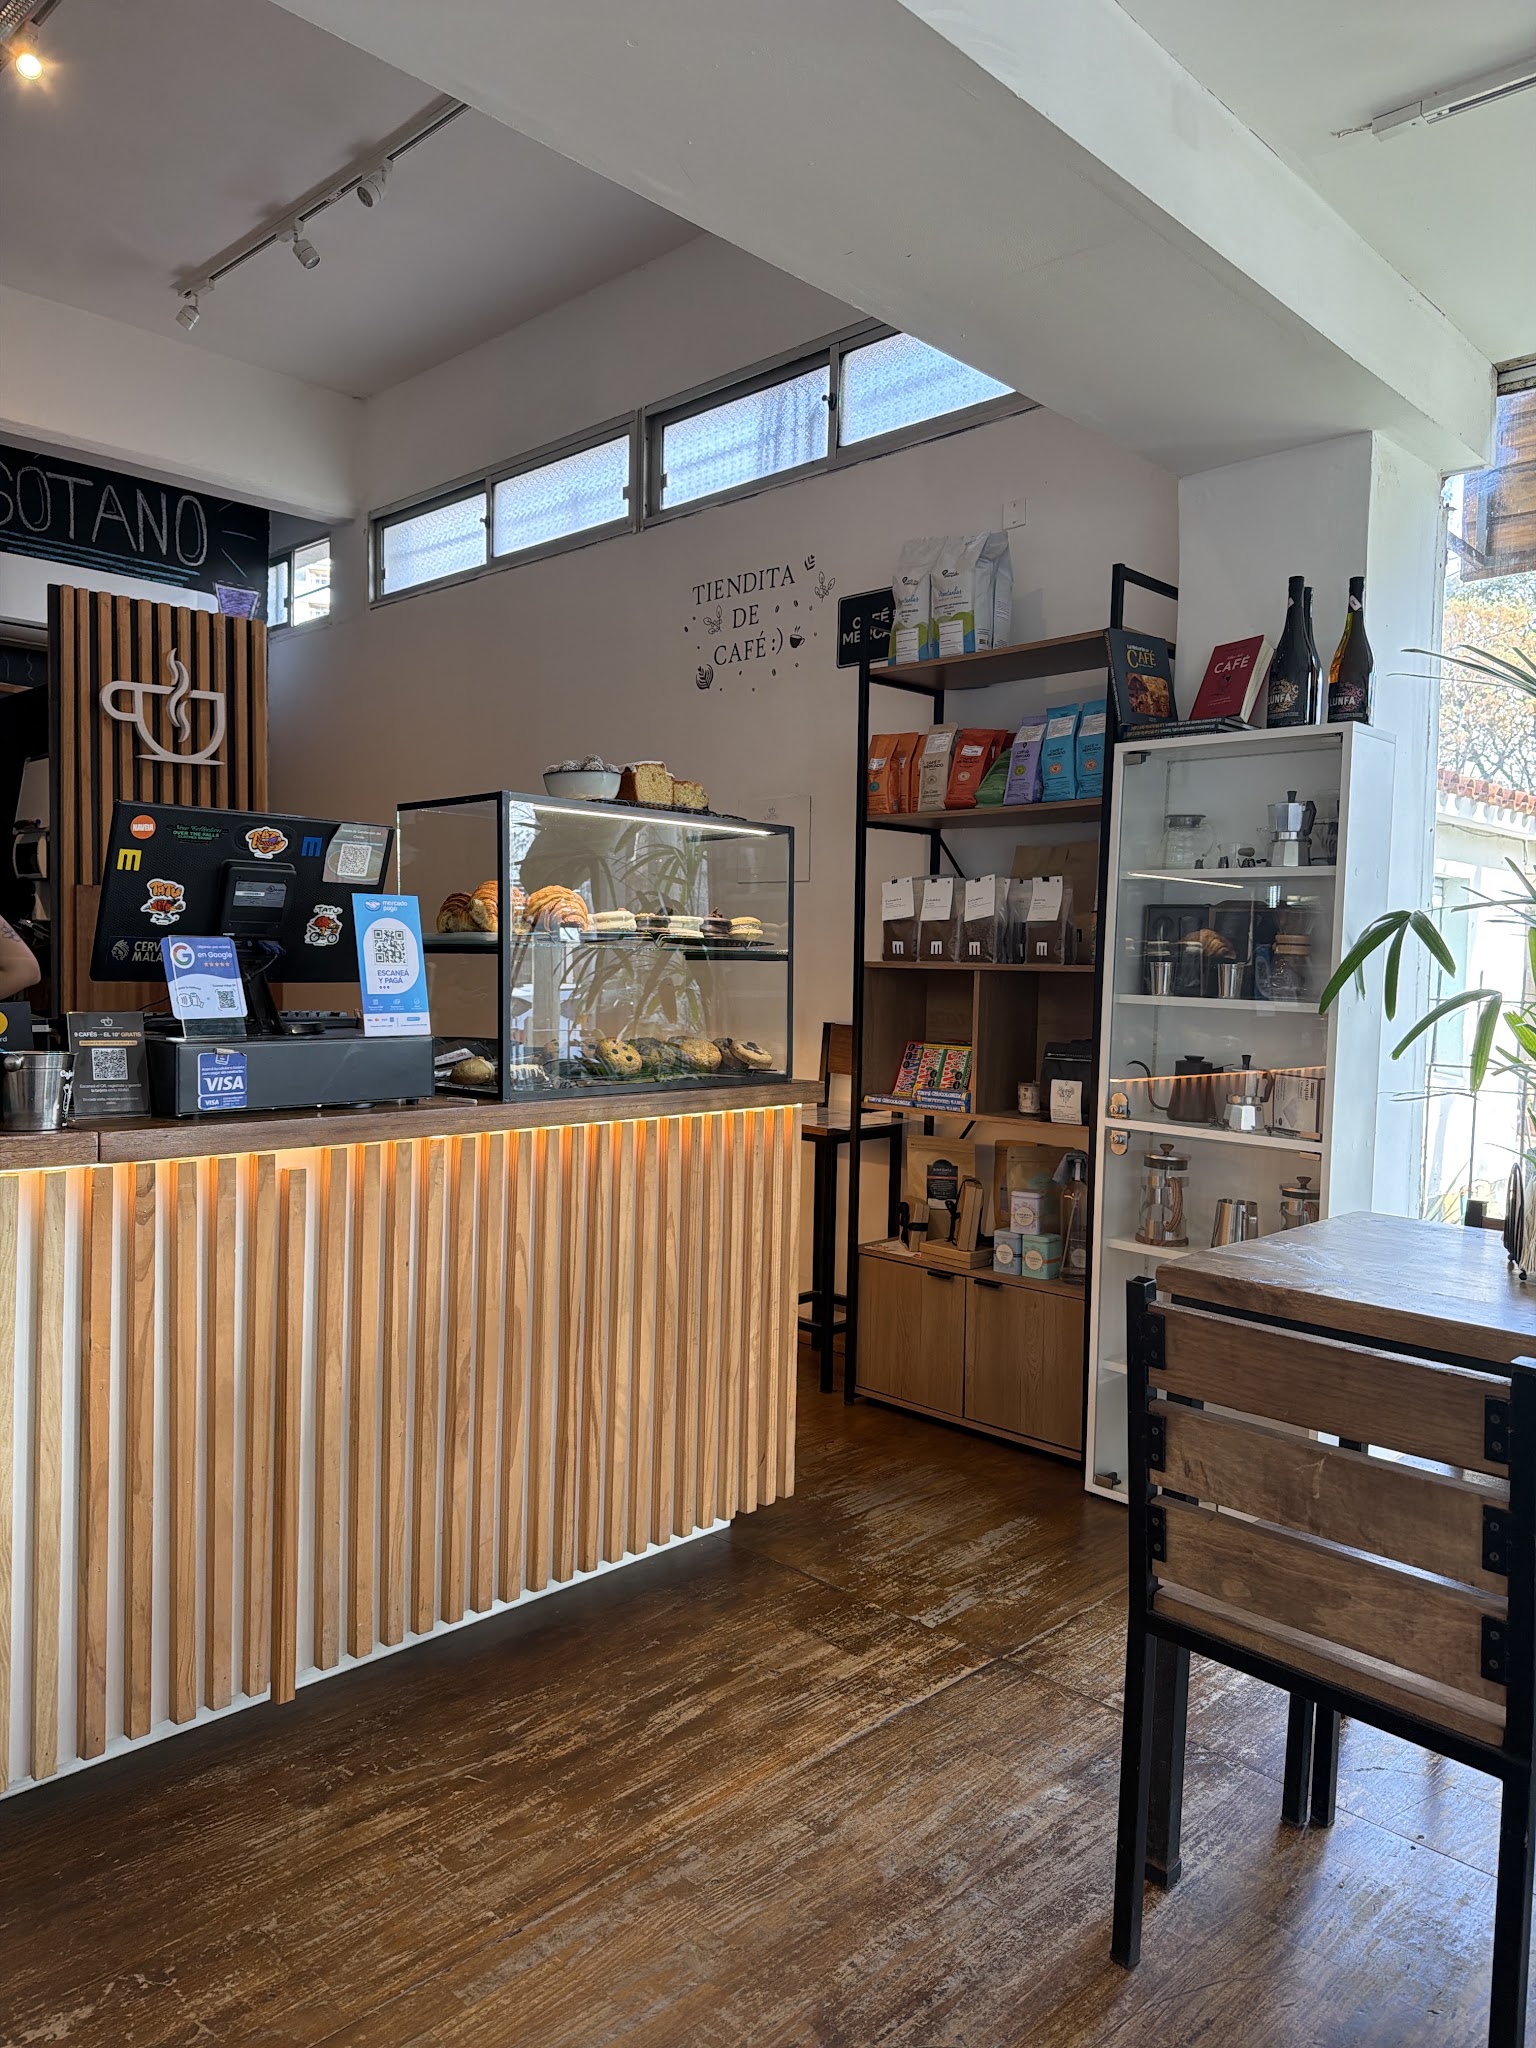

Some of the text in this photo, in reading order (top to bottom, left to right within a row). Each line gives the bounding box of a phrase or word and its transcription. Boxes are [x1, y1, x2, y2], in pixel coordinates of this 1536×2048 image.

[692, 564, 796, 606] TIENDITA
[732, 604, 760, 629] DE
[852, 606, 890, 630] CFÉ
[713, 630, 766, 666] CAFÉ
[1126, 649, 1157, 669] CAFÉ
[1214, 654, 1251, 674] CAFÉ
[134, 941, 161, 951] CERV
[132, 952, 163, 963] MALA
[208, 951, 233, 960] Google
[377, 969, 410, 977] ESCANEÁ
[384, 976, 404, 984] PAGÁ
[203, 1075, 245, 1092] VISA
